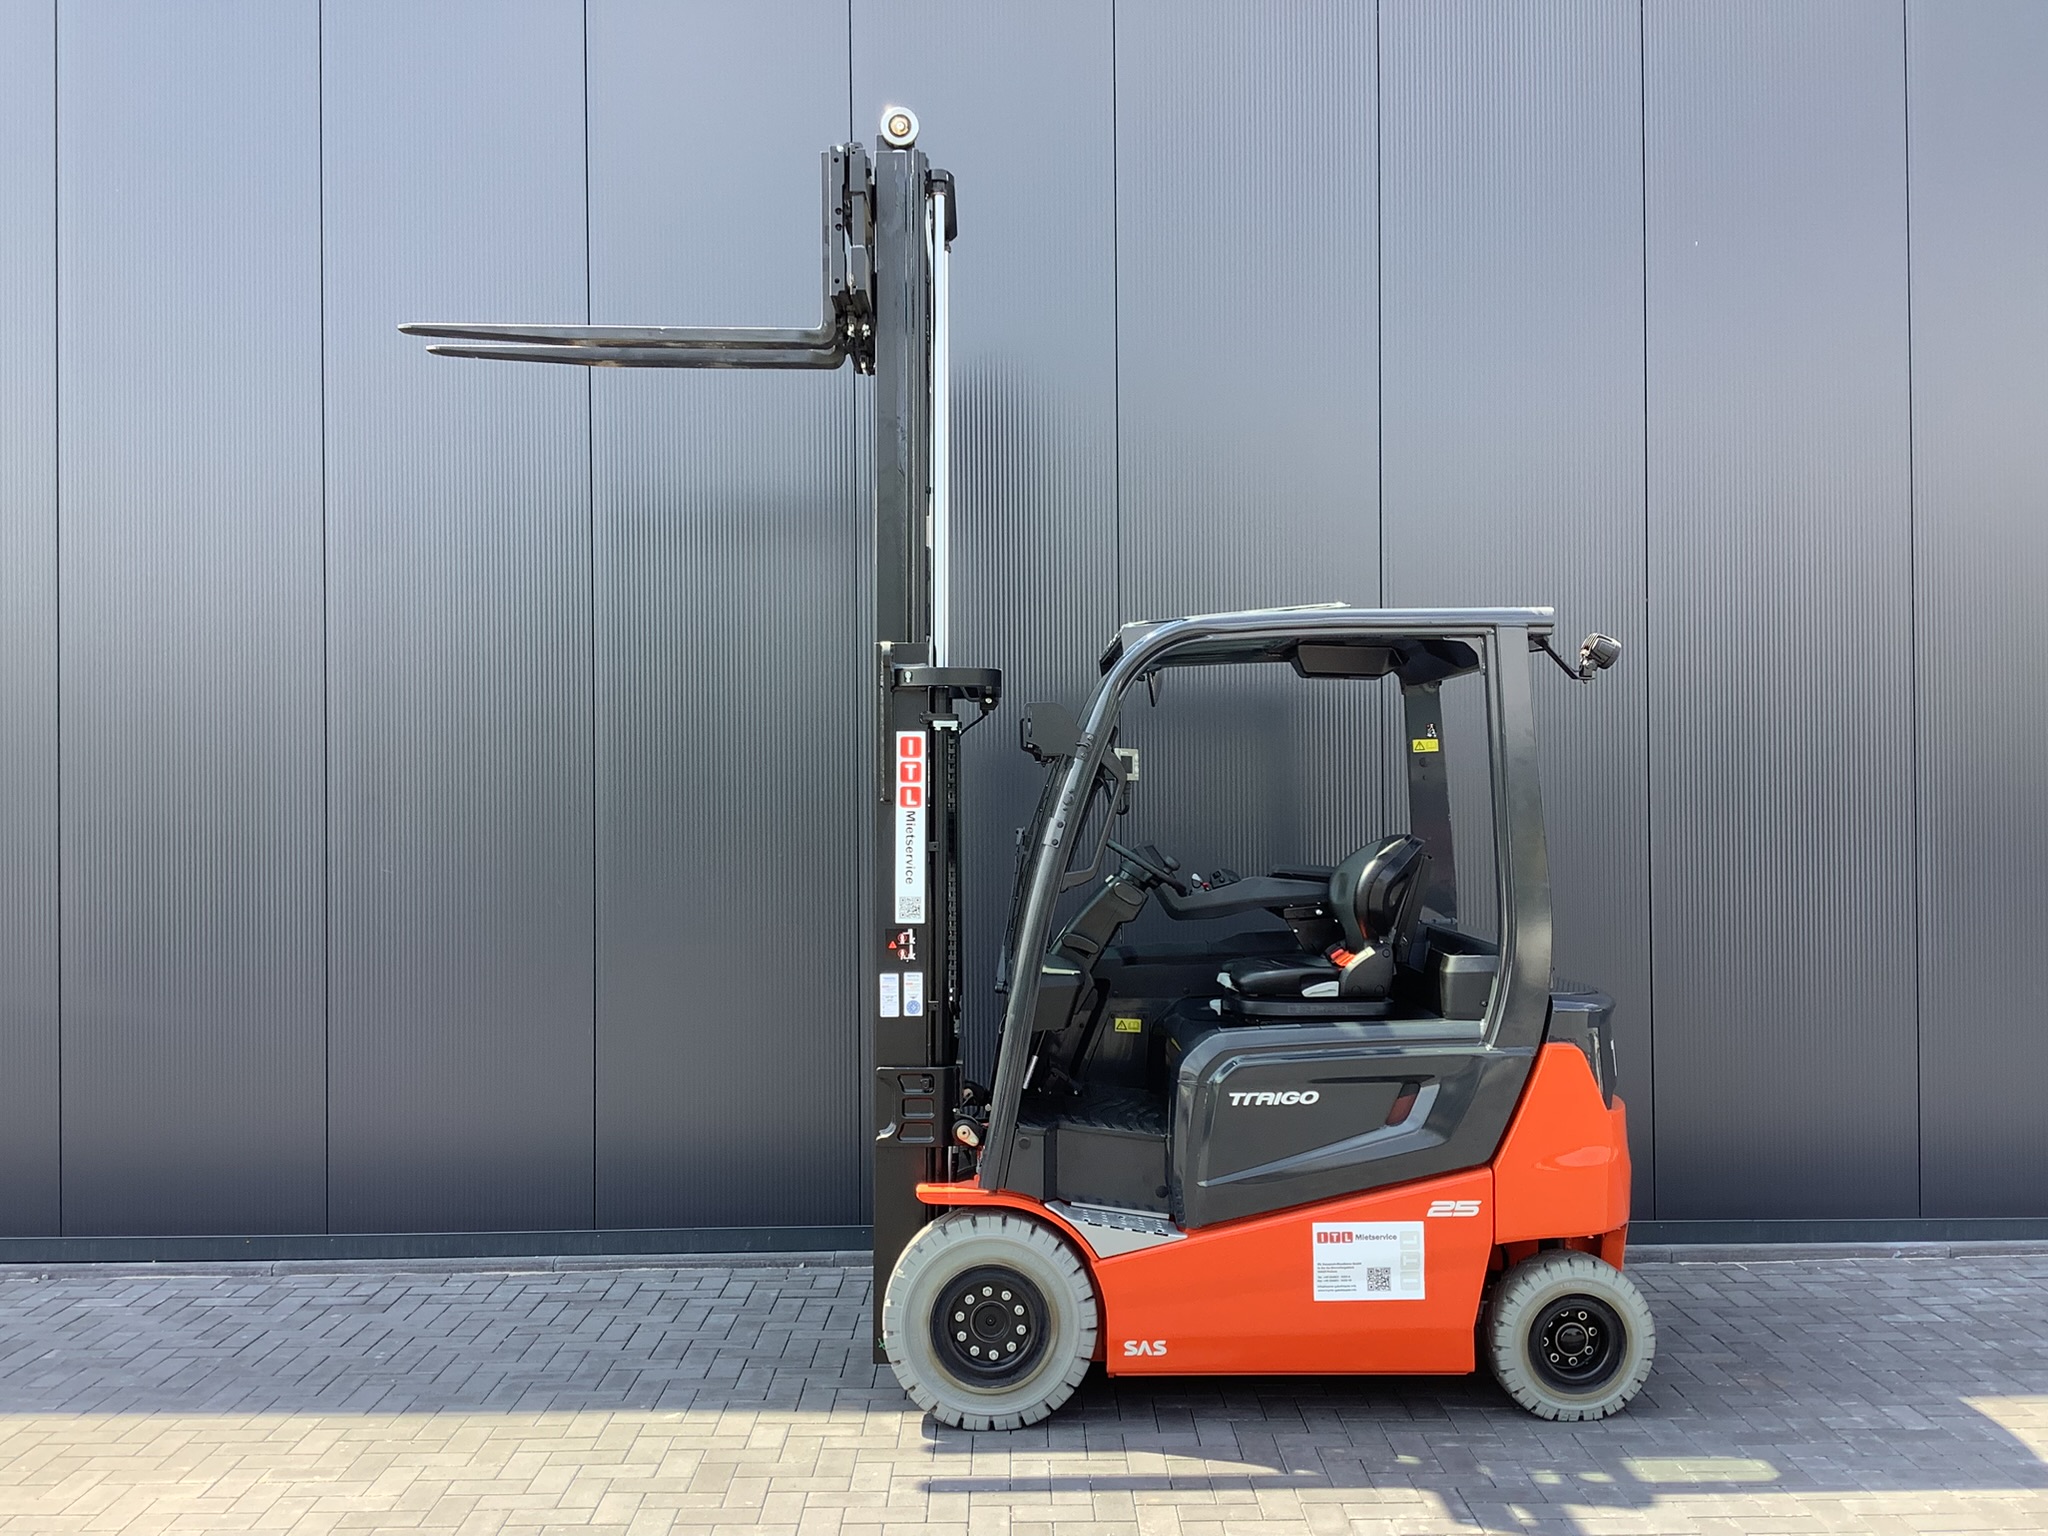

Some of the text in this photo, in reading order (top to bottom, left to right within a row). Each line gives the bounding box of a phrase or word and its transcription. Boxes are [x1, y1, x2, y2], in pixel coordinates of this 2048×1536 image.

[902, 738, 919, 885] ITL Mietservice
[1427, 1200, 1482, 1217] 25
[1318, 1232, 1398, 1243] ITL Mietservice
[1123, 1340, 1167, 1356] SAS
